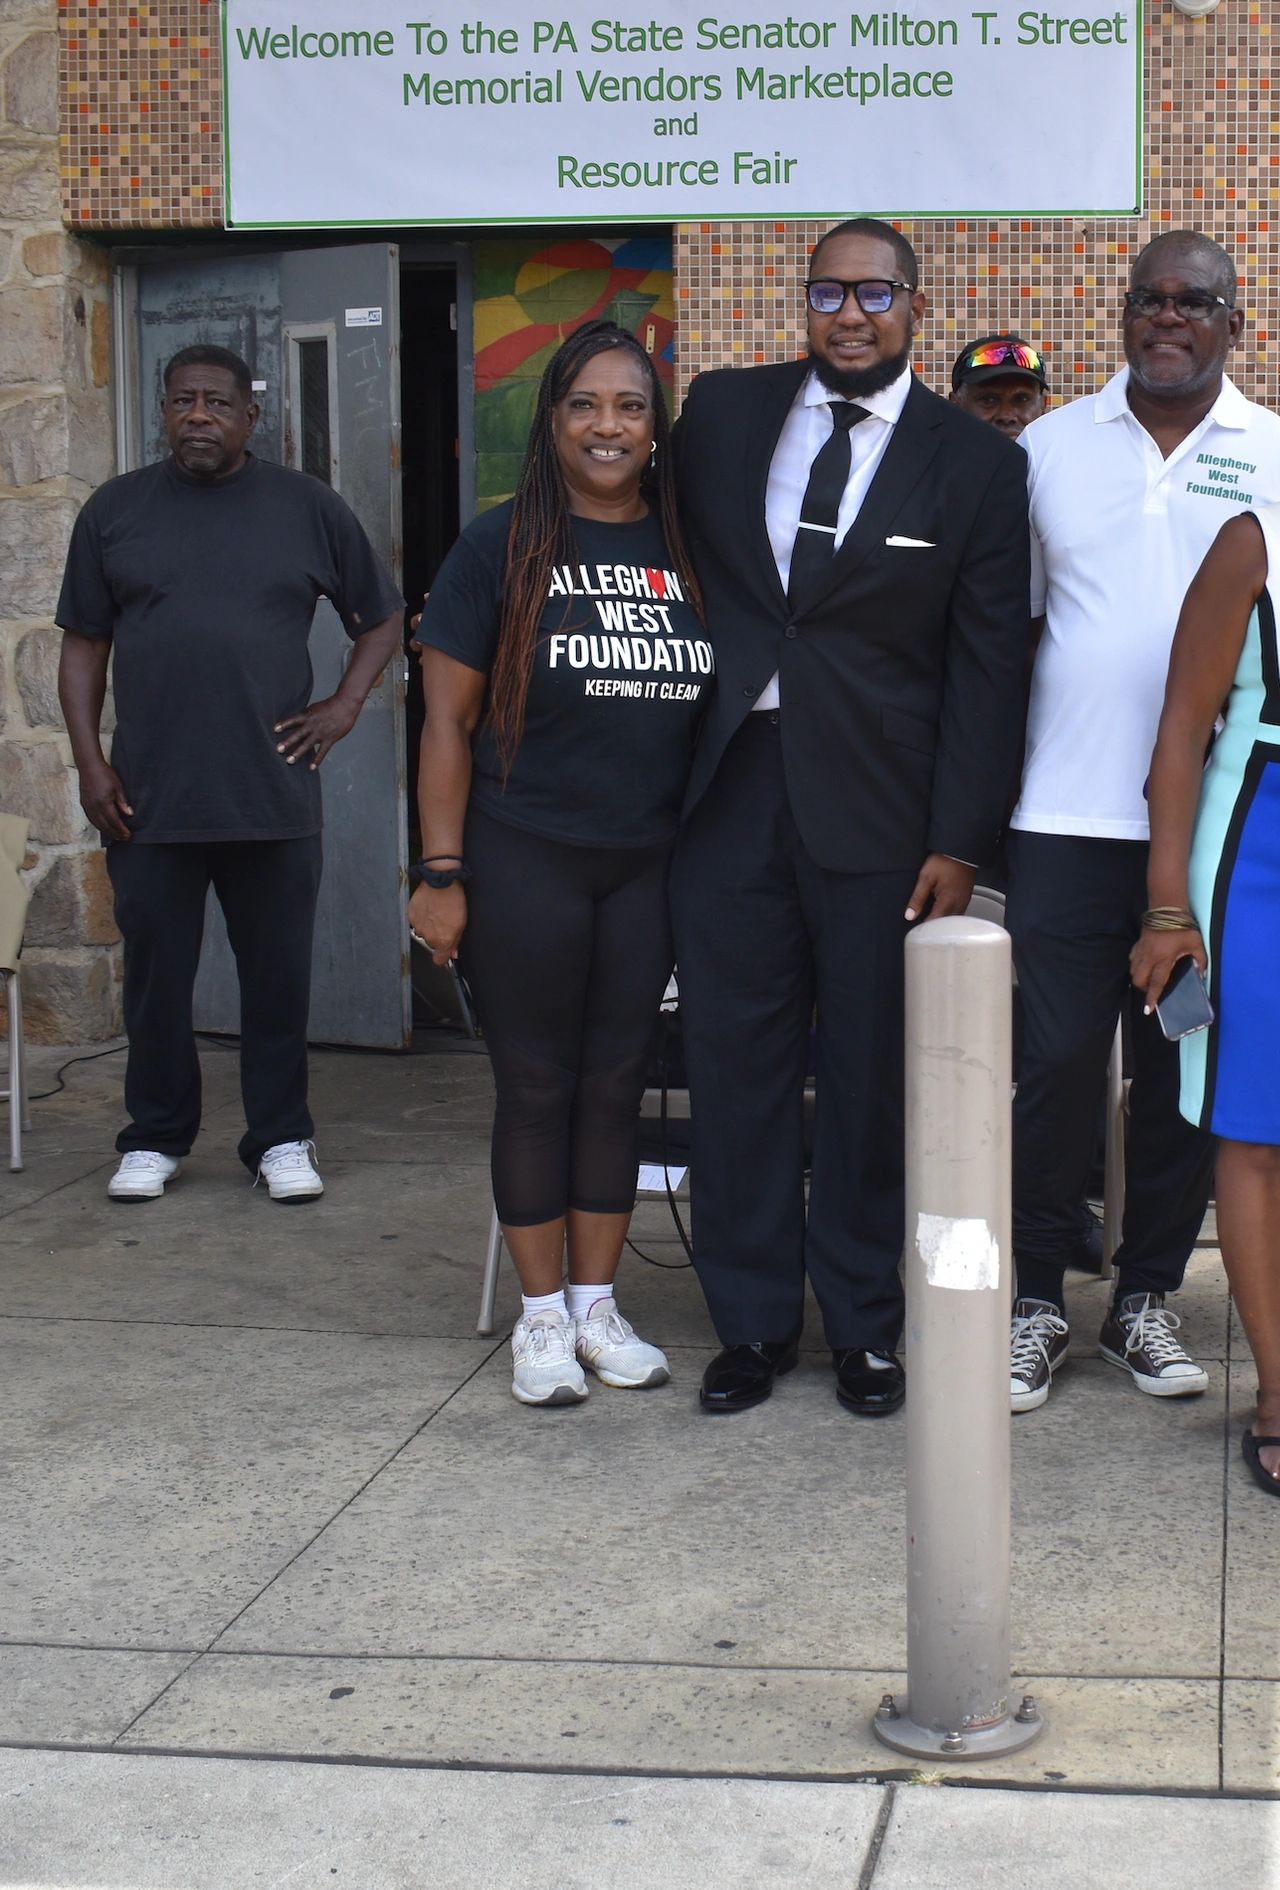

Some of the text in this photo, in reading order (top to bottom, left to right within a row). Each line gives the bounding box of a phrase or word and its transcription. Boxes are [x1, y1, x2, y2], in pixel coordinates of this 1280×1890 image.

[236, 12, 1127, 59] Welcome To the PA State Senator Milton T. Street
[404, 63, 952, 105] Memorial Vendors Marketplace
[654, 112, 697, 136] and
[558, 152, 797, 188] Resource Fair
[1196, 453, 1257, 474] Allegheny
[1208, 469, 1239, 484] West
[1186, 482, 1253, 504] Foundation
[548, 564, 691, 603] ALLEGHN
[595, 600, 674, 634] WEST
[585, 679, 701, 701] KEEPING IT CLEAN
